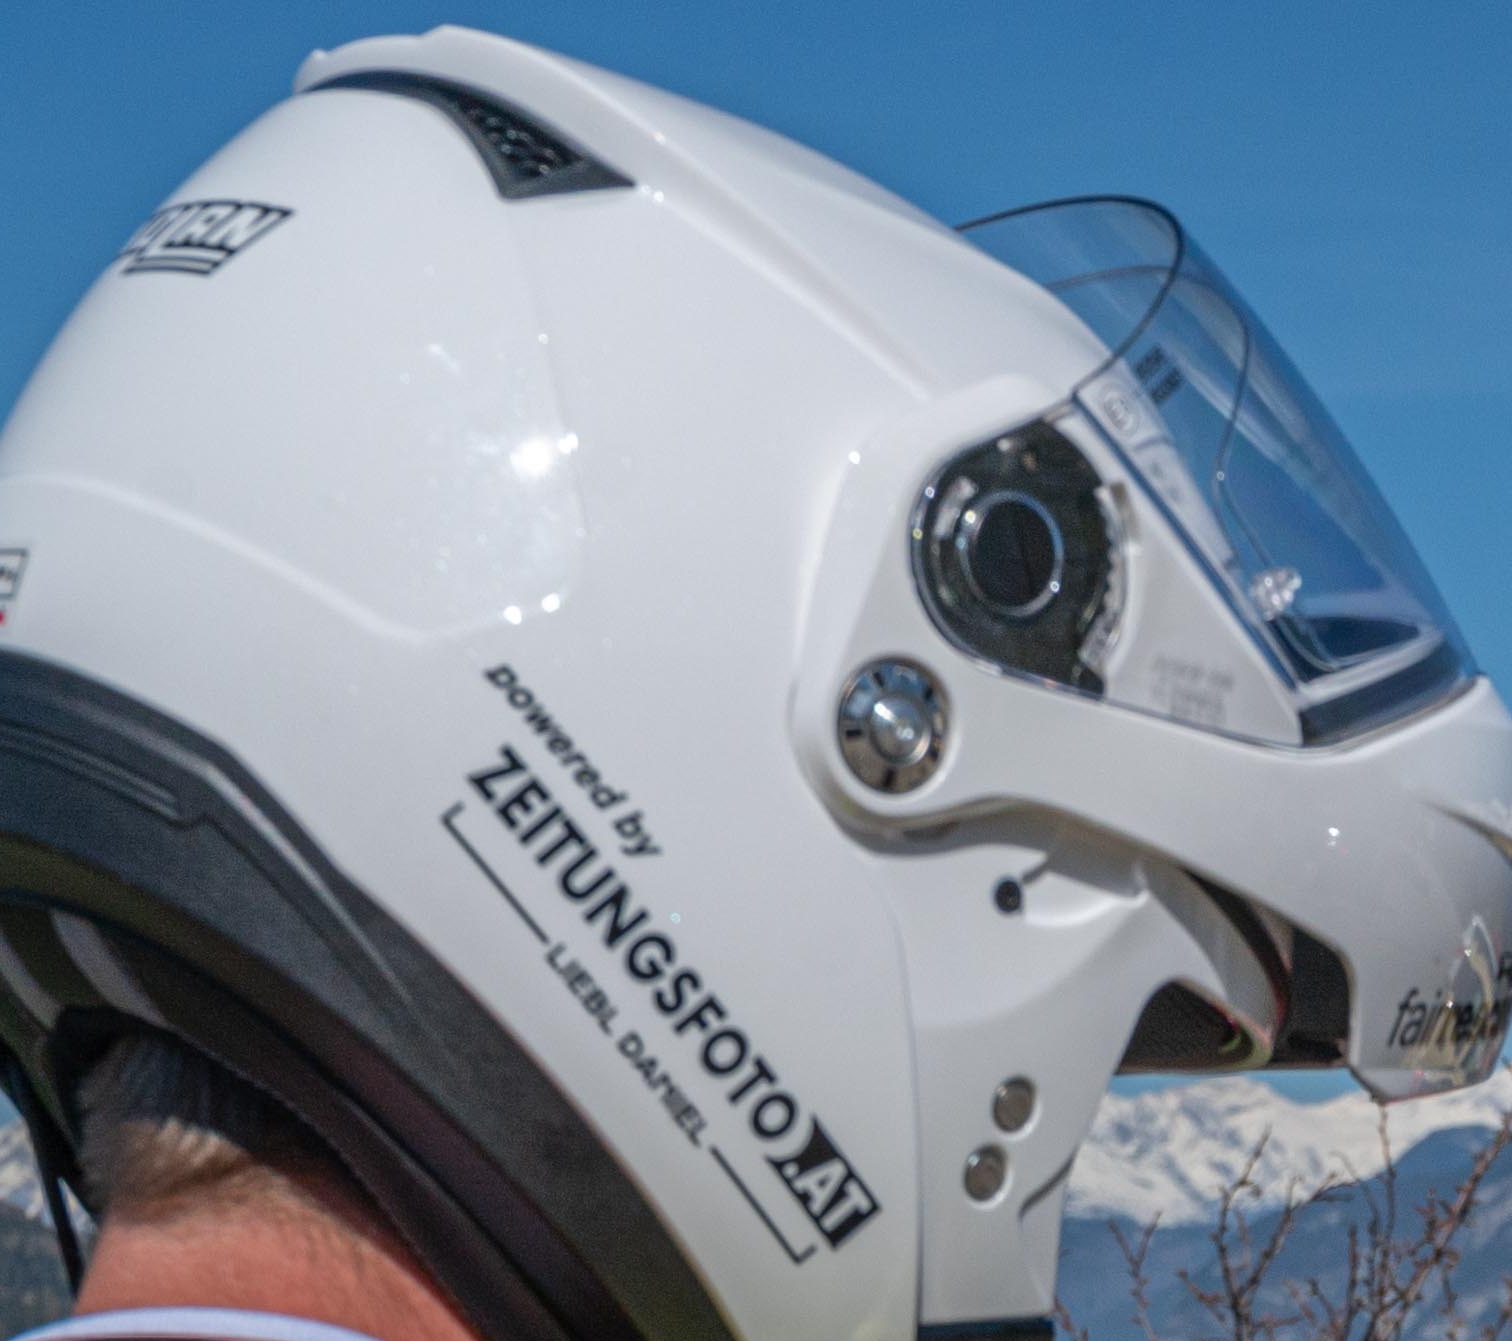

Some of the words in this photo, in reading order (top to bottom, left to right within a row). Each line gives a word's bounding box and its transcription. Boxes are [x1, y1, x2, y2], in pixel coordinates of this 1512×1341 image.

[484, 663, 628, 811] powered
[612, 809, 663, 858] by
[467, 744, 881, 1248] ZEITUNGSFOTO.AT
[545, 942, 619, 1036] LIEBL
[616, 1030, 708, 1148] DANIEL
